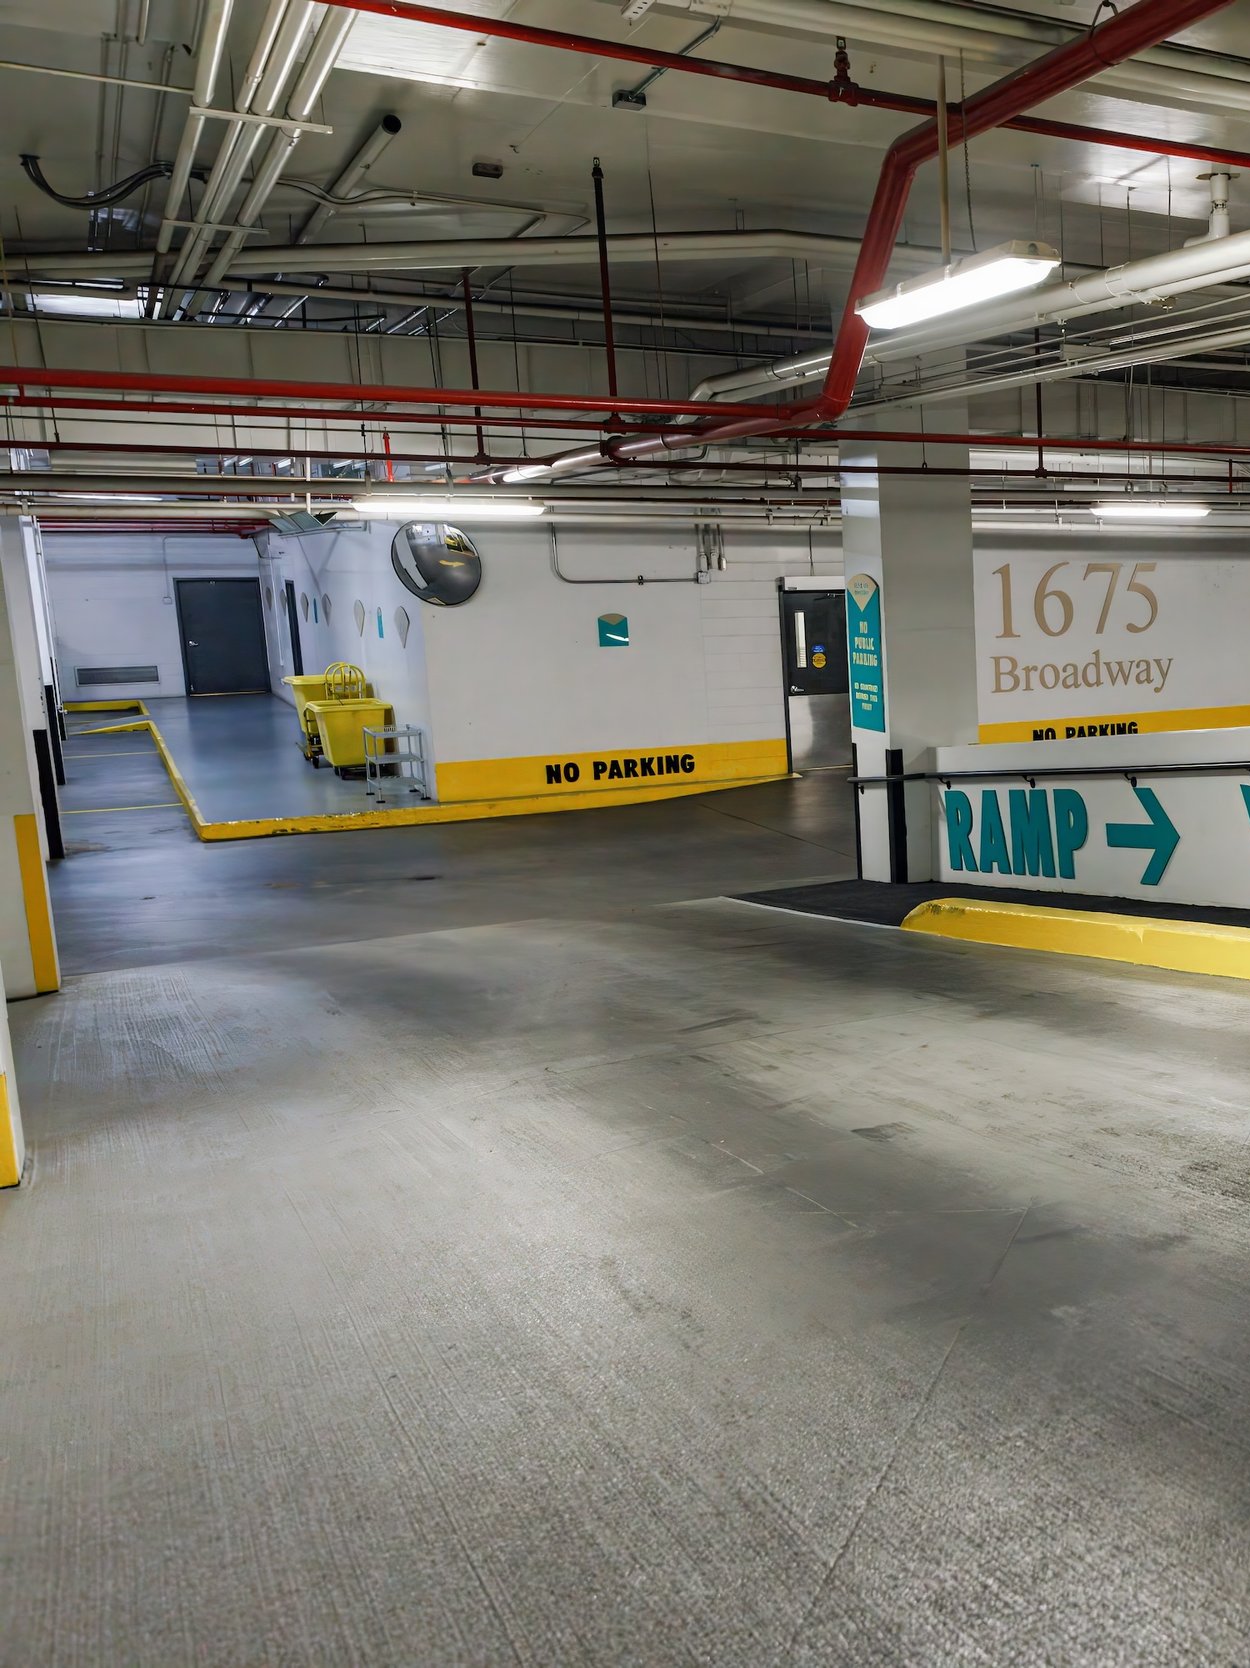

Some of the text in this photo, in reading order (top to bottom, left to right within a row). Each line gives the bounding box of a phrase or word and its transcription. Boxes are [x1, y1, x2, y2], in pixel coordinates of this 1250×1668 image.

[991, 562, 1159, 639] 1675
[859, 621, 868, 634] NO
[852, 651, 878, 667] PARKING
[989, 649, 1174, 694] Broadway
[1032, 721, 1139, 742] NO PARKING
[545, 753, 695, 785] NO PARKING
[944, 788, 1089, 880] RAMP
